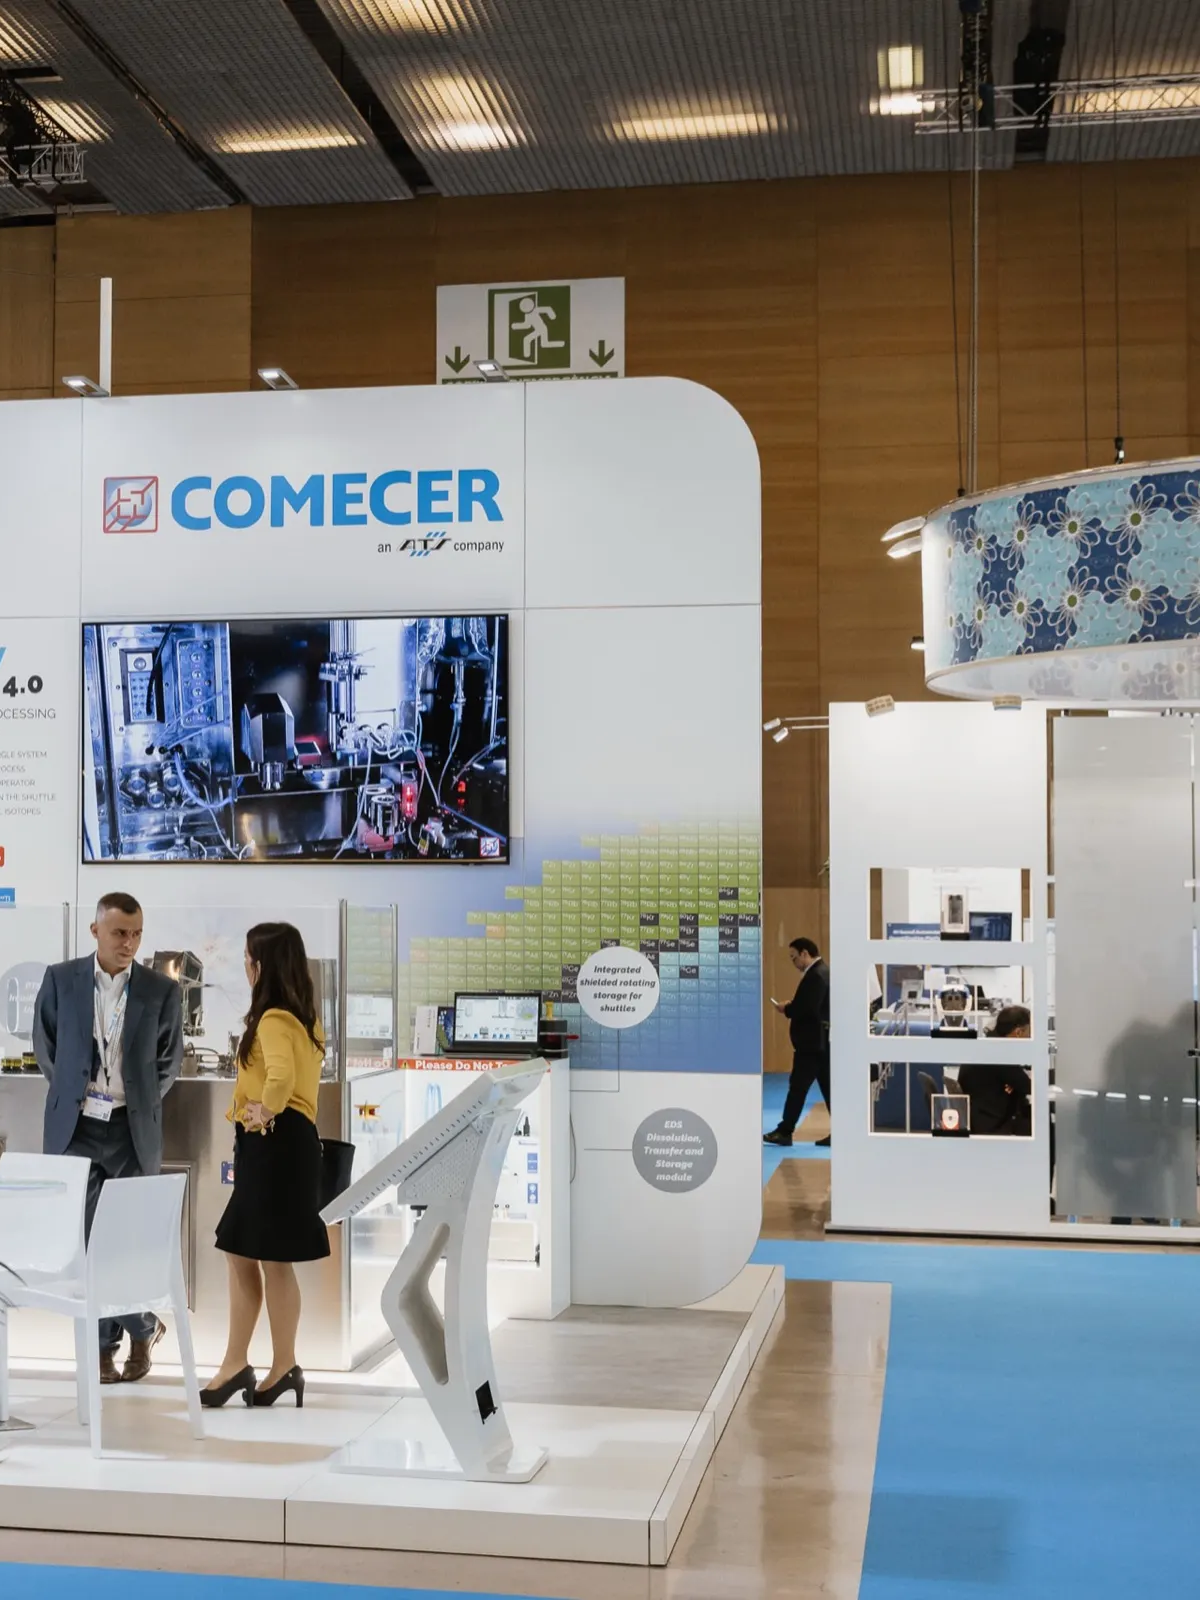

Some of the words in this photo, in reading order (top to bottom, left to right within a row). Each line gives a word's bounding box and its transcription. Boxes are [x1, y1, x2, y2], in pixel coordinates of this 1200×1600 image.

[171, 469, 504, 531] COMECER
[377, 543, 392, 553] an
[453, 541, 505, 553] company
[2, 675, 43, 697] 4.0
[594, 965, 642, 975] Integrated
[580, 979, 618, 987] shielded
[619, 979, 656, 988] rotating
[593, 992, 628, 1001] storage
[629, 992, 643, 1001] for
[600, 1004, 636, 1012] shuttles
[415, 1060, 453, 1070] Please
[455, 1060, 471, 1070] Do
[473, 1060, 493, 1070] Not
[664, 1120, 683, 1129] EDS
[646, 1133, 702, 1143] Dissolution,
[644, 1146, 684, 1156] Transfer
[684, 1147, 704, 1156] and
[655, 1159, 693, 1170] Storage
[656, 1173, 692, 1181] module
